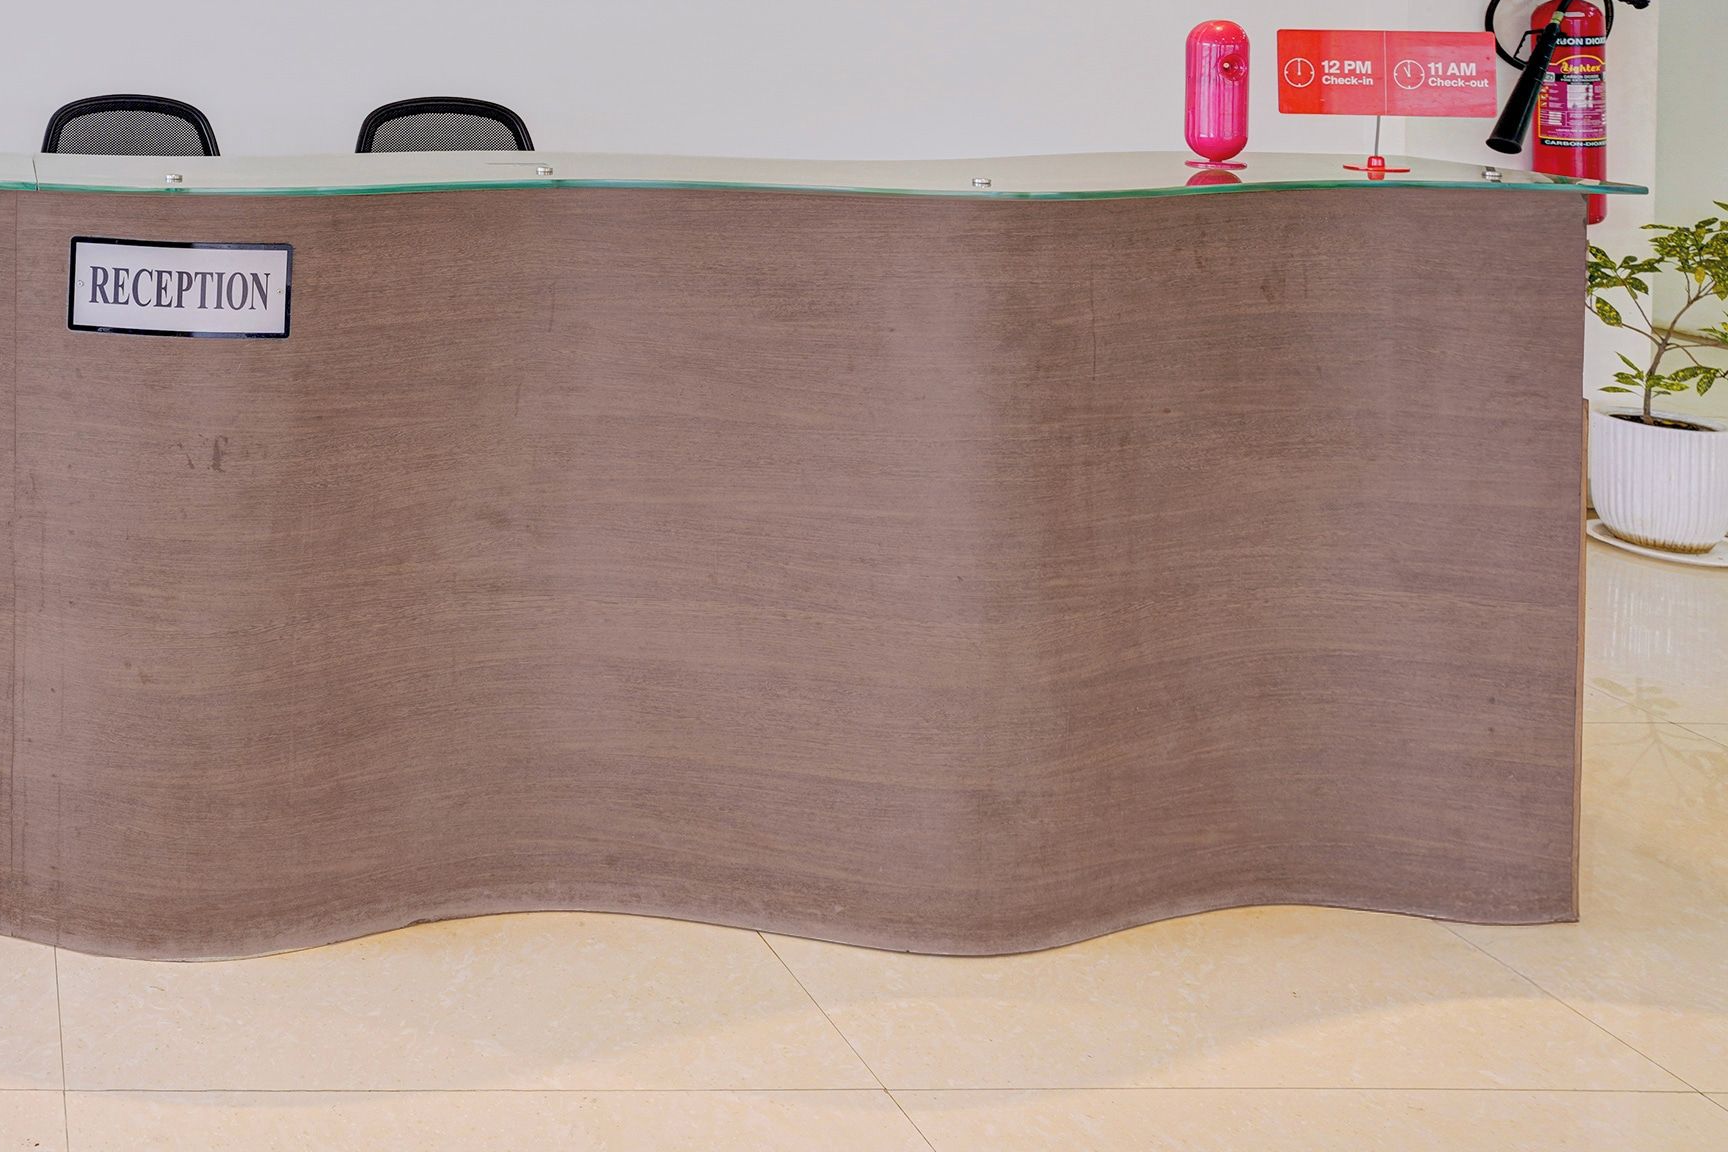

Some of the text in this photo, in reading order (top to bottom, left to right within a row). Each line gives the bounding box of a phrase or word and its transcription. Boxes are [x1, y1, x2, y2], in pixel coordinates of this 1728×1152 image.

[1322, 60, 1371, 74] 12 PM
[1428, 63, 1476, 76] 11 AM
[1322, 76, 1373, 85] Check-in
[1428, 78, 1488, 87] Check-out
[89, 266, 270, 310] RECEPTION
